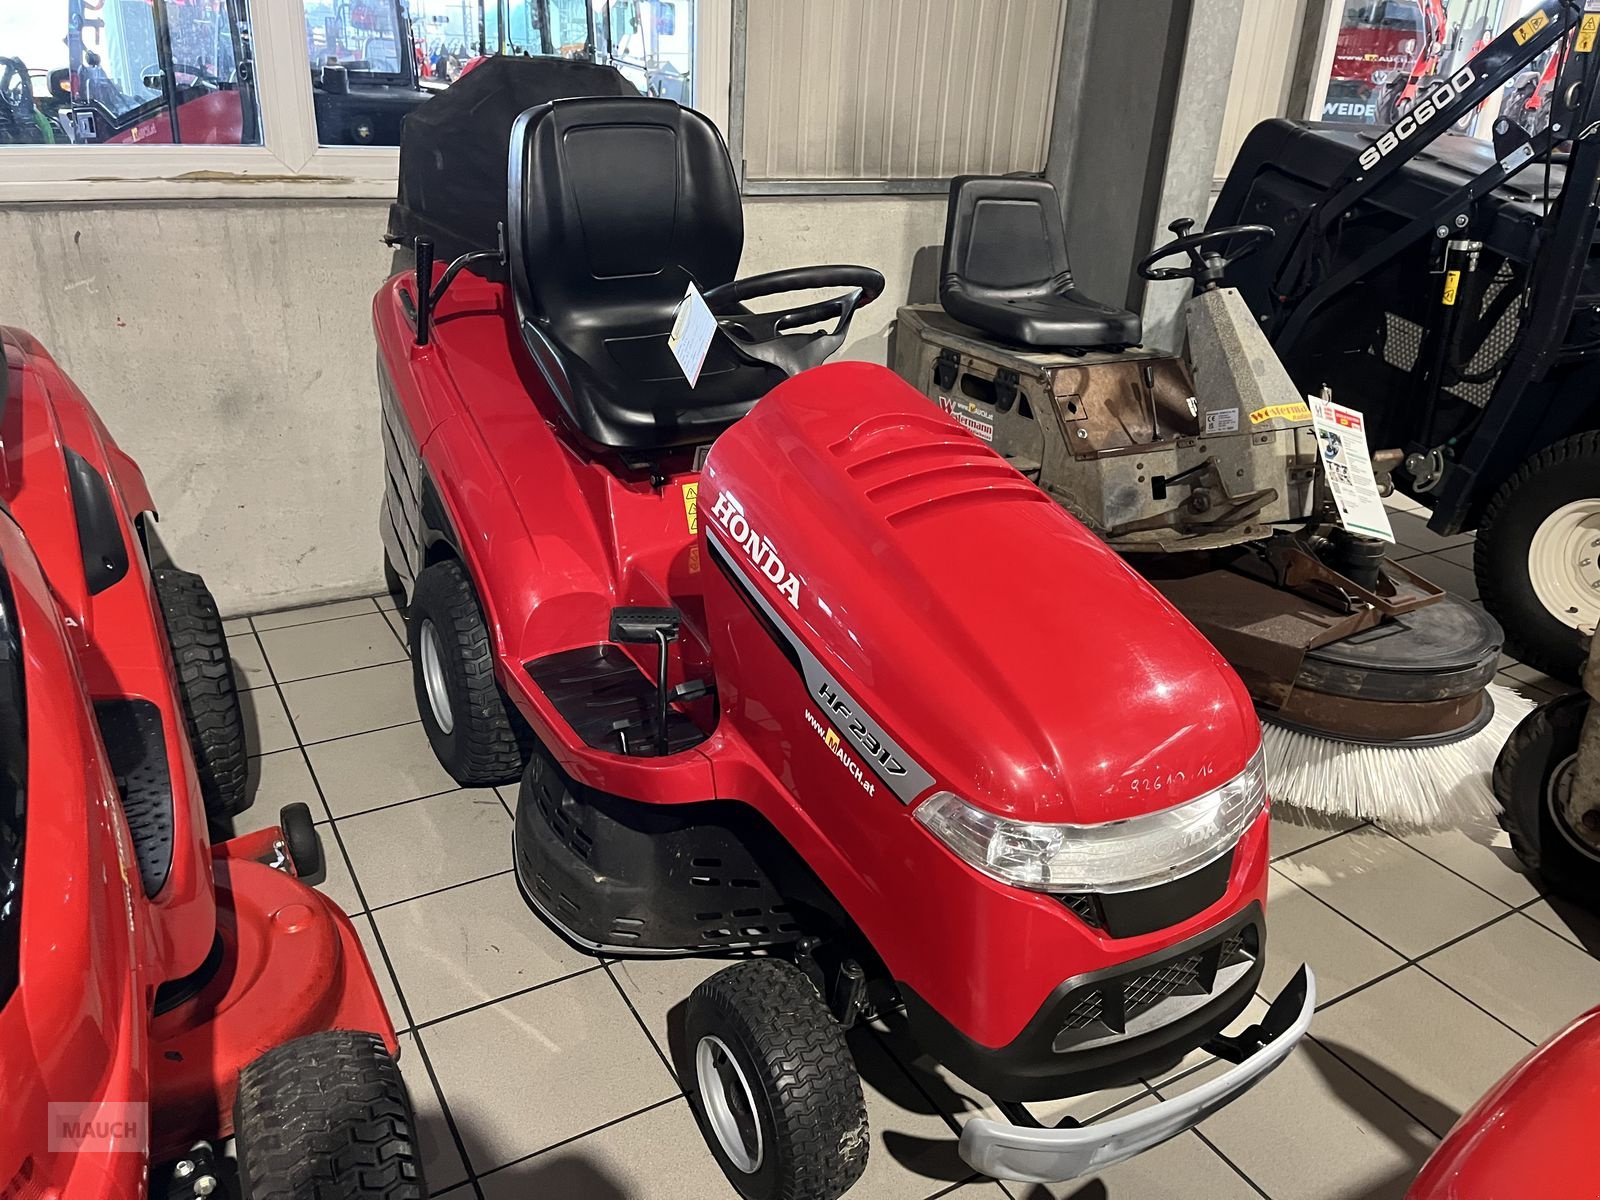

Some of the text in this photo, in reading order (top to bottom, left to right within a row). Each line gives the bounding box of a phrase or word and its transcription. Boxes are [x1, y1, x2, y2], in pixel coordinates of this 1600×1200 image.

[1323, 102, 1377, 116] WEIDE
[1359, 67, 1476, 171] SBC600
[1250, 405, 1308, 421] Westerma
[711, 491, 801, 610] HONDA
[804, 708, 876, 797] www.MAUCH.at
[818, 683, 908, 777] HF 2317
